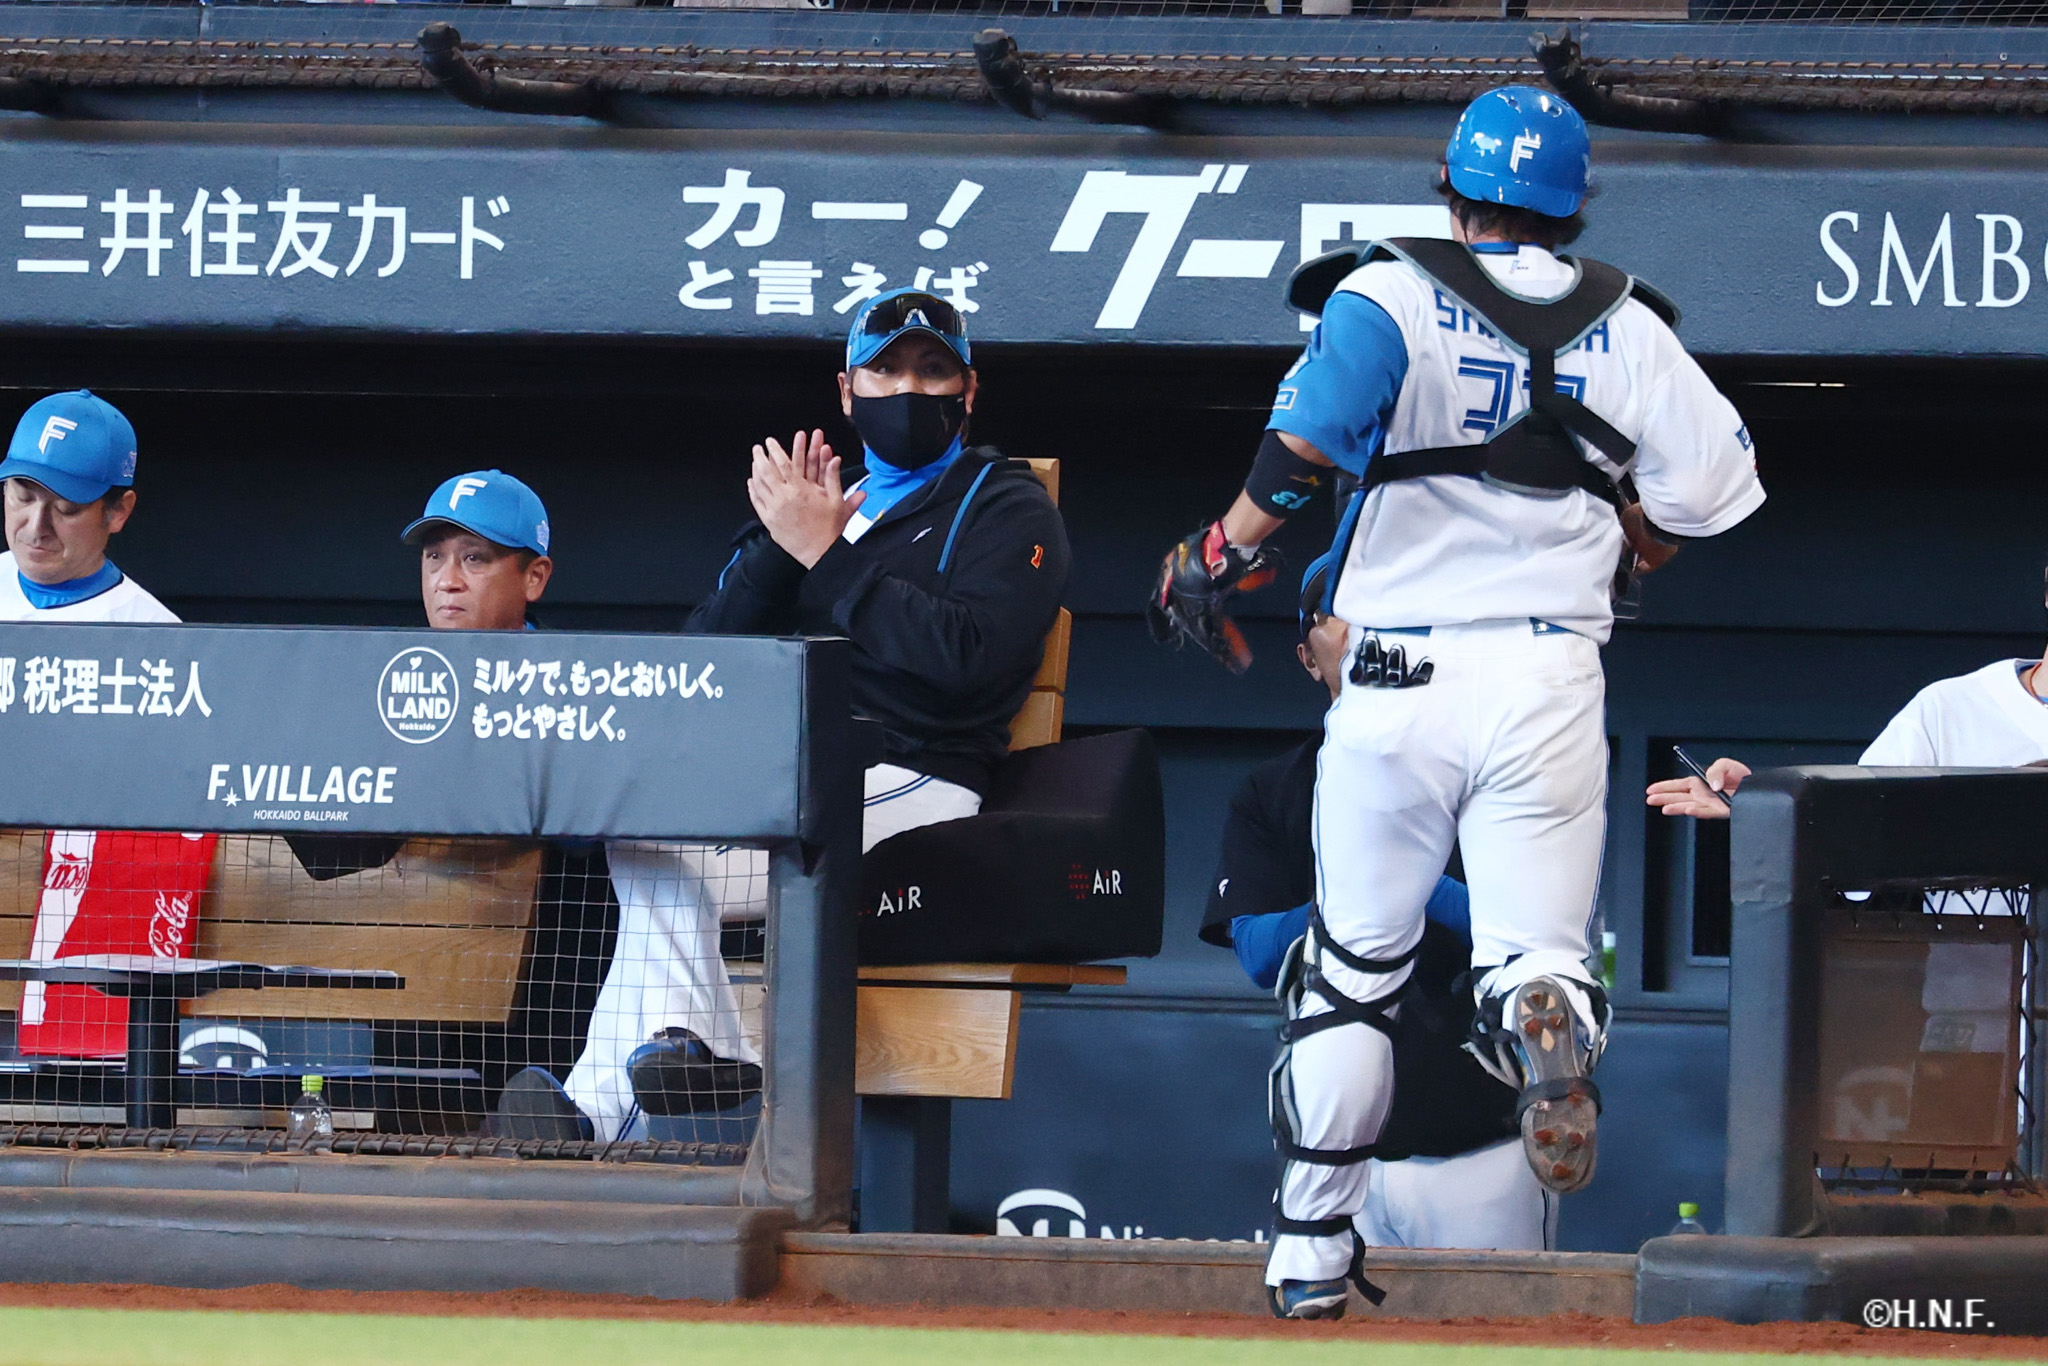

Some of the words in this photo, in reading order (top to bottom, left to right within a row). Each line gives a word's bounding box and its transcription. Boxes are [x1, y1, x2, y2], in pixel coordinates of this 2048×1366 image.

[17, 187, 511, 280] 三井住友カード
[1049, 164, 1452, 332] グー
[1816, 210, 2048, 308] SMB
[678, 260, 990, 315] と言えば
[37, 415, 78, 455] F
[448, 477, 488, 512] F
[473, 657, 724, 700] ミルクで、もっとおいしく。
[387, 696, 451, 720] LAND
[399, 721, 436, 732] Hokkaido
[472, 702, 626, 742] もっとやさしく。
[253, 809, 301, 821] HOKKAIDO
[303, 810, 350, 822] BALLPARK
[148, 891, 190, 958] Cola
